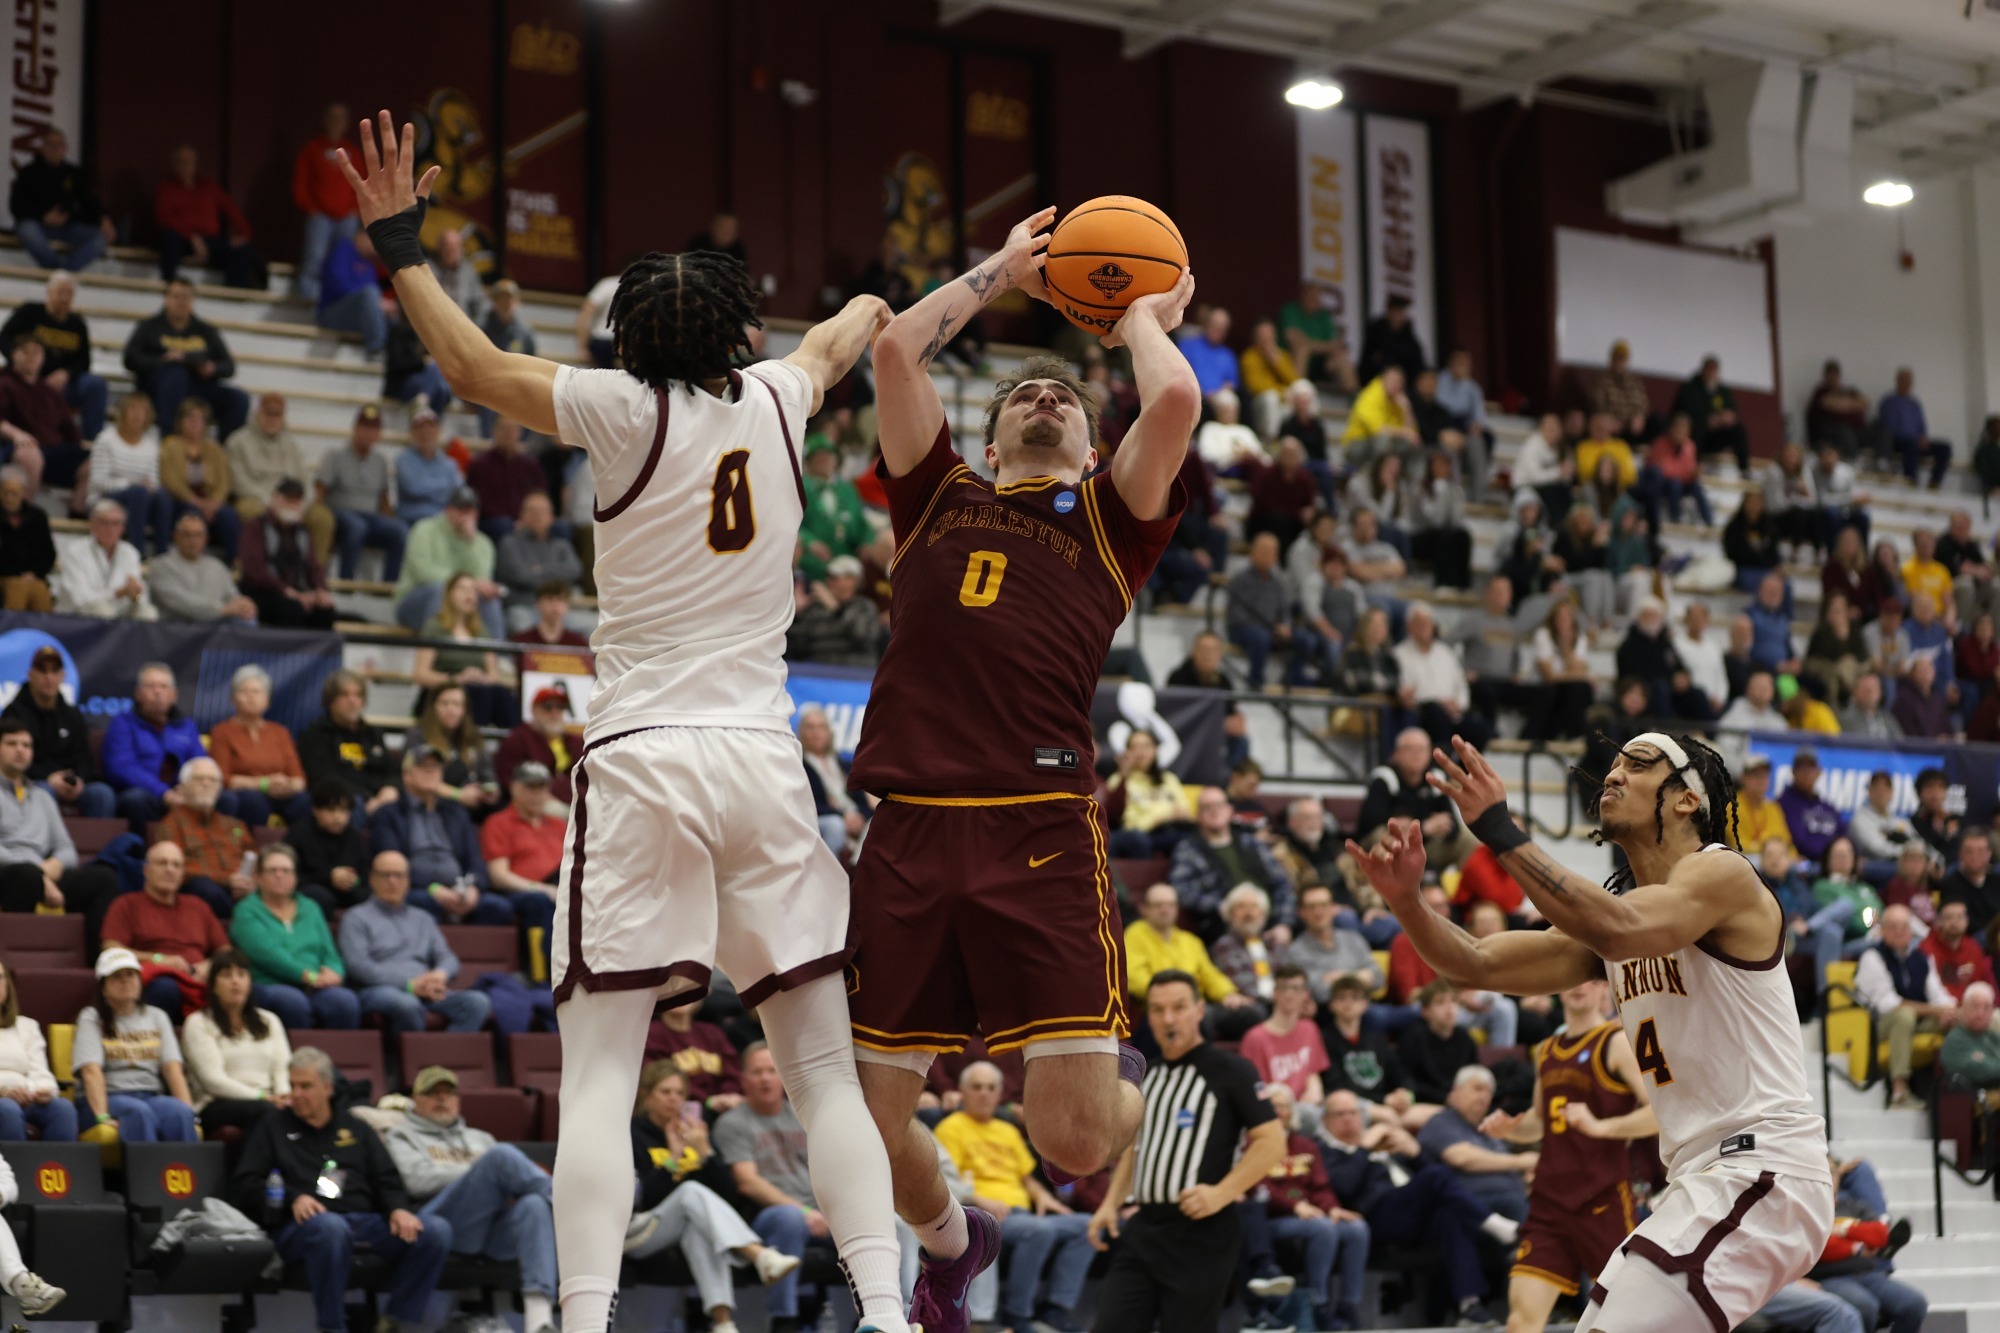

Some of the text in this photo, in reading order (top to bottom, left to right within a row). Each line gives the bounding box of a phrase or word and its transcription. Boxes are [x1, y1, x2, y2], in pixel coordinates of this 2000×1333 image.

[1309, 154, 1346, 341] OLDEN
[706, 448, 757, 556] 0
[1055, 499, 1075, 509] NCAA
[927, 505, 1083, 570] CHARLESTON
[958, 550, 1008, 607] 0
[1064, 754, 1073, 764] M
[1635, 1016, 1675, 1089] 4
[1549, 1095, 1568, 1134] 5
[1742, 1138, 1750, 1146] L
[39, 1168, 67, 1193] GU
[165, 1169, 193, 1194] GU
